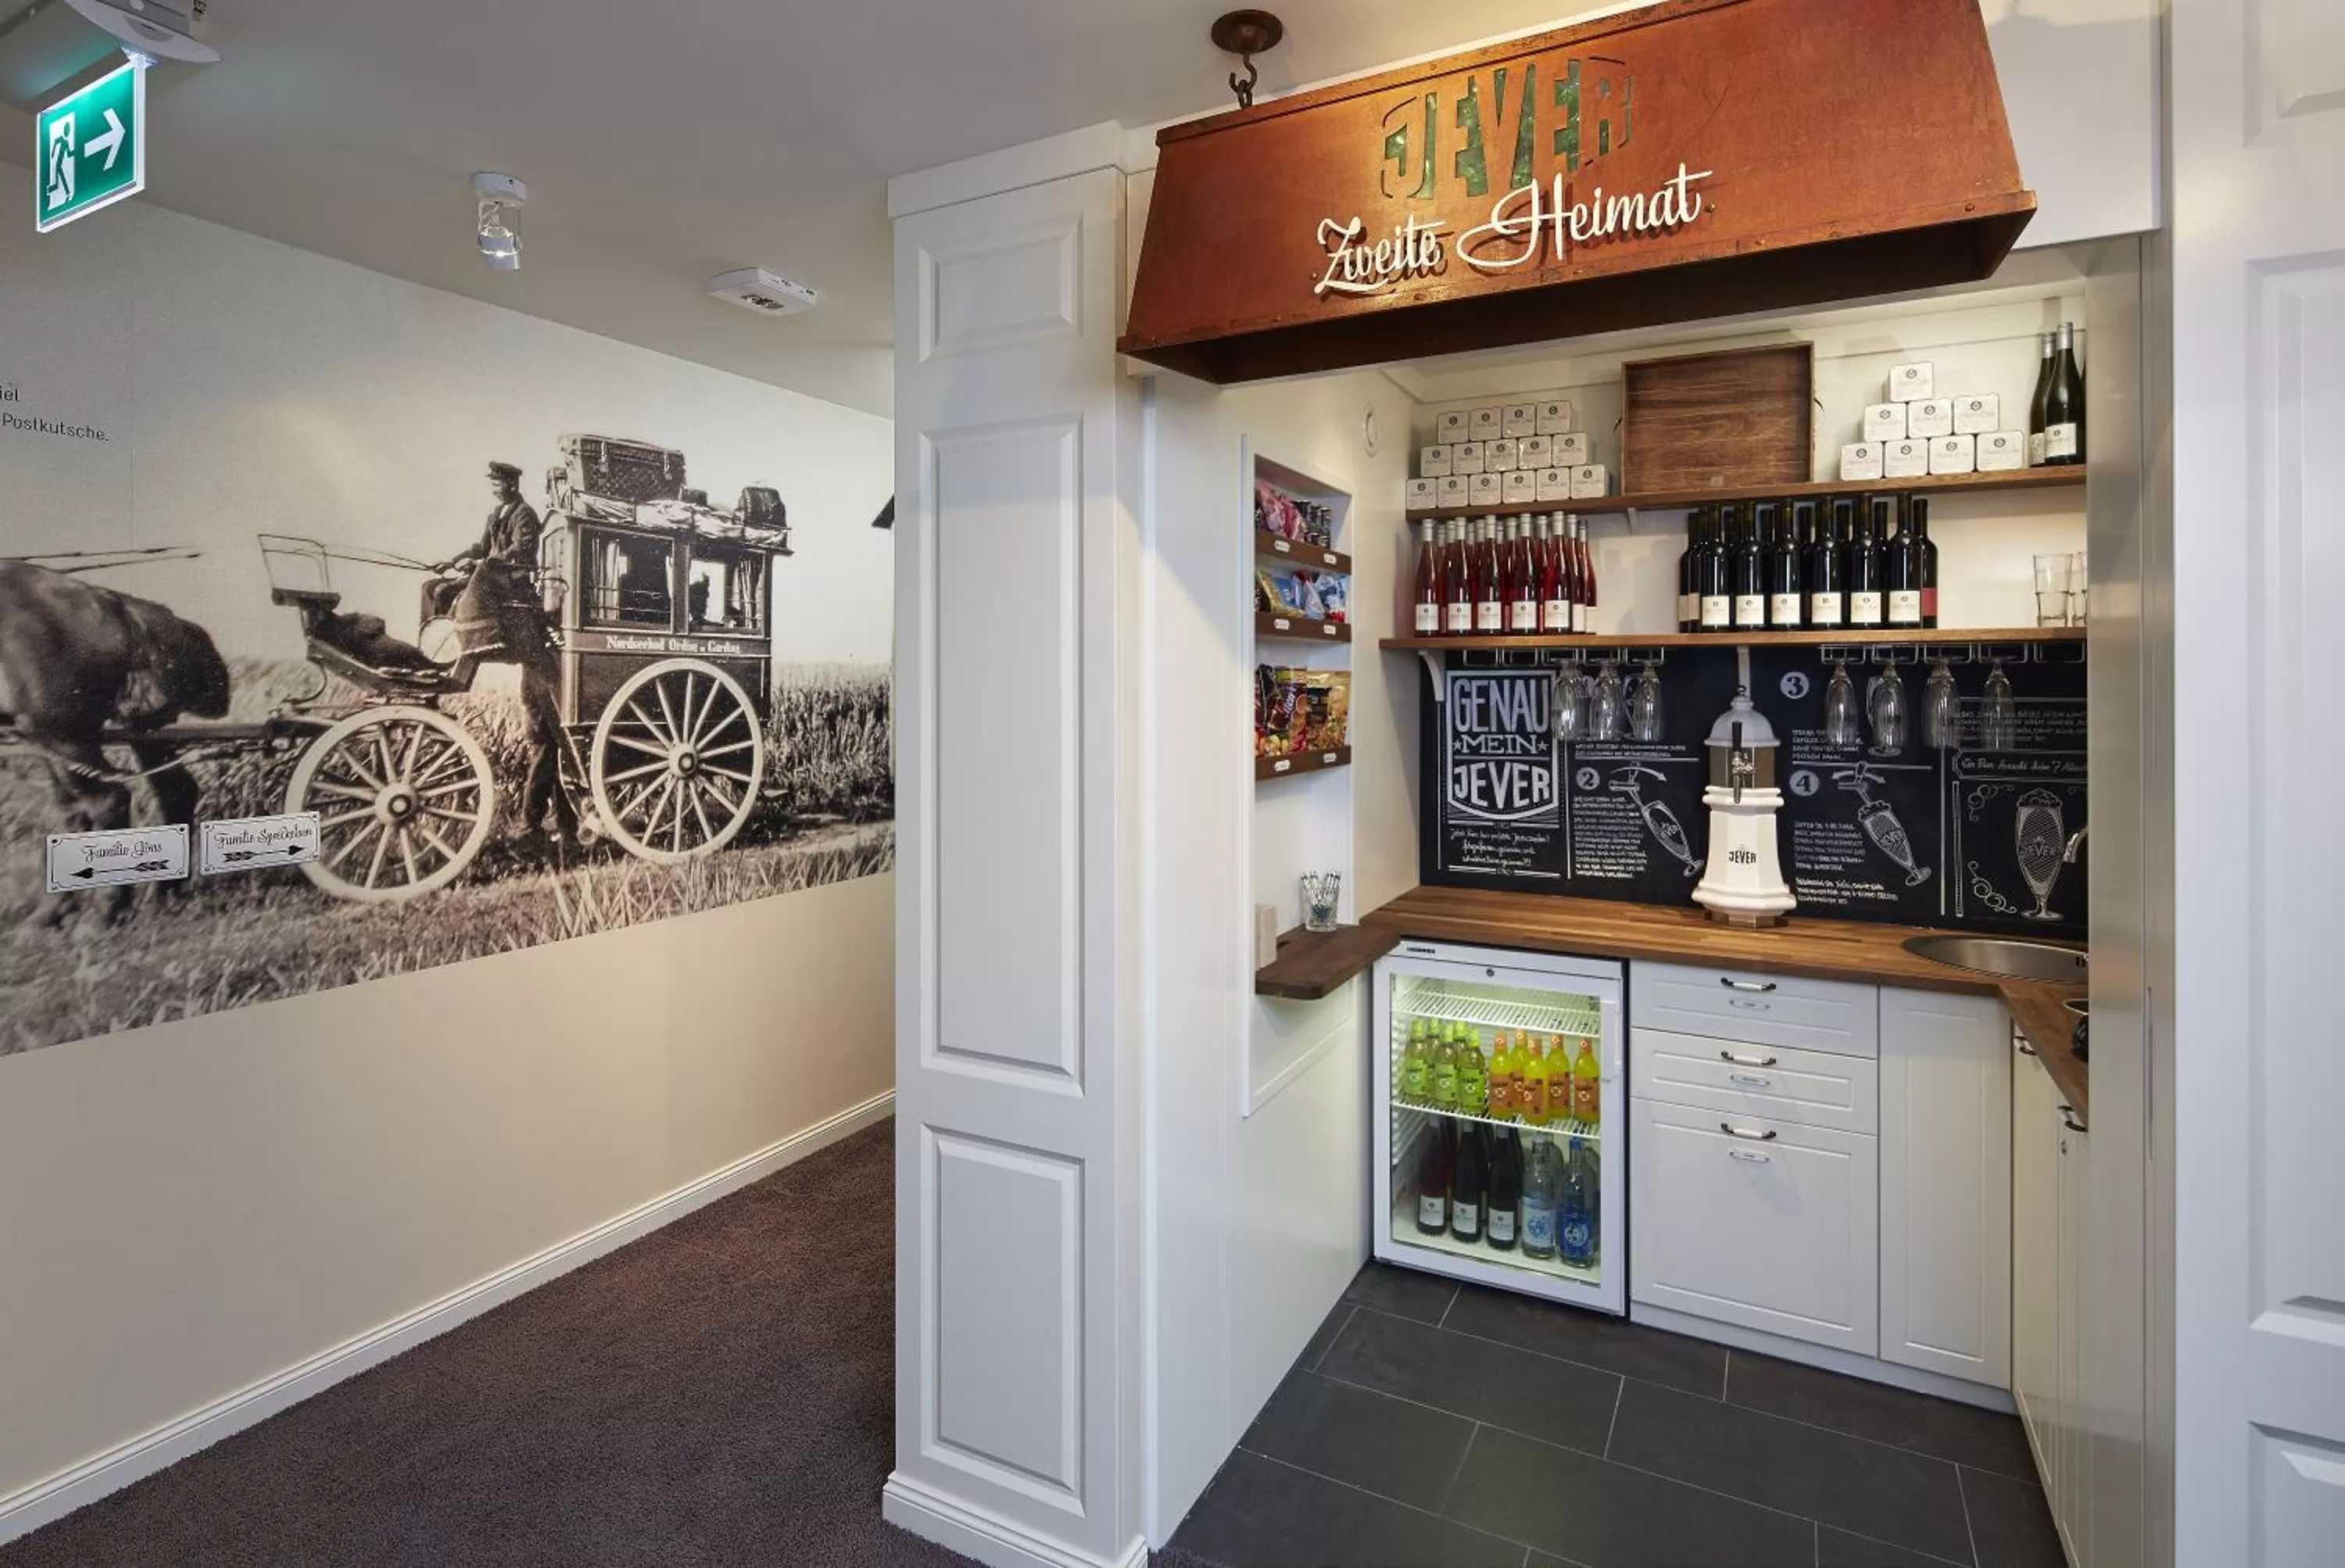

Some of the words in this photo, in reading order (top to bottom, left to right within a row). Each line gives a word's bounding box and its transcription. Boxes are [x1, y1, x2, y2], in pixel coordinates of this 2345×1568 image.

[1380, 57, 1632, 201] JEVER
[1314, 213, 1446, 295] Zweite
[1456, 163, 1713, 268] Heimat
[1453, 678, 1551, 733] GENAU
[1461, 734, 1538, 755] MEIN
[1453, 761, 1551, 809] JEVER
[1728, 850, 1757, 864] JEVER
